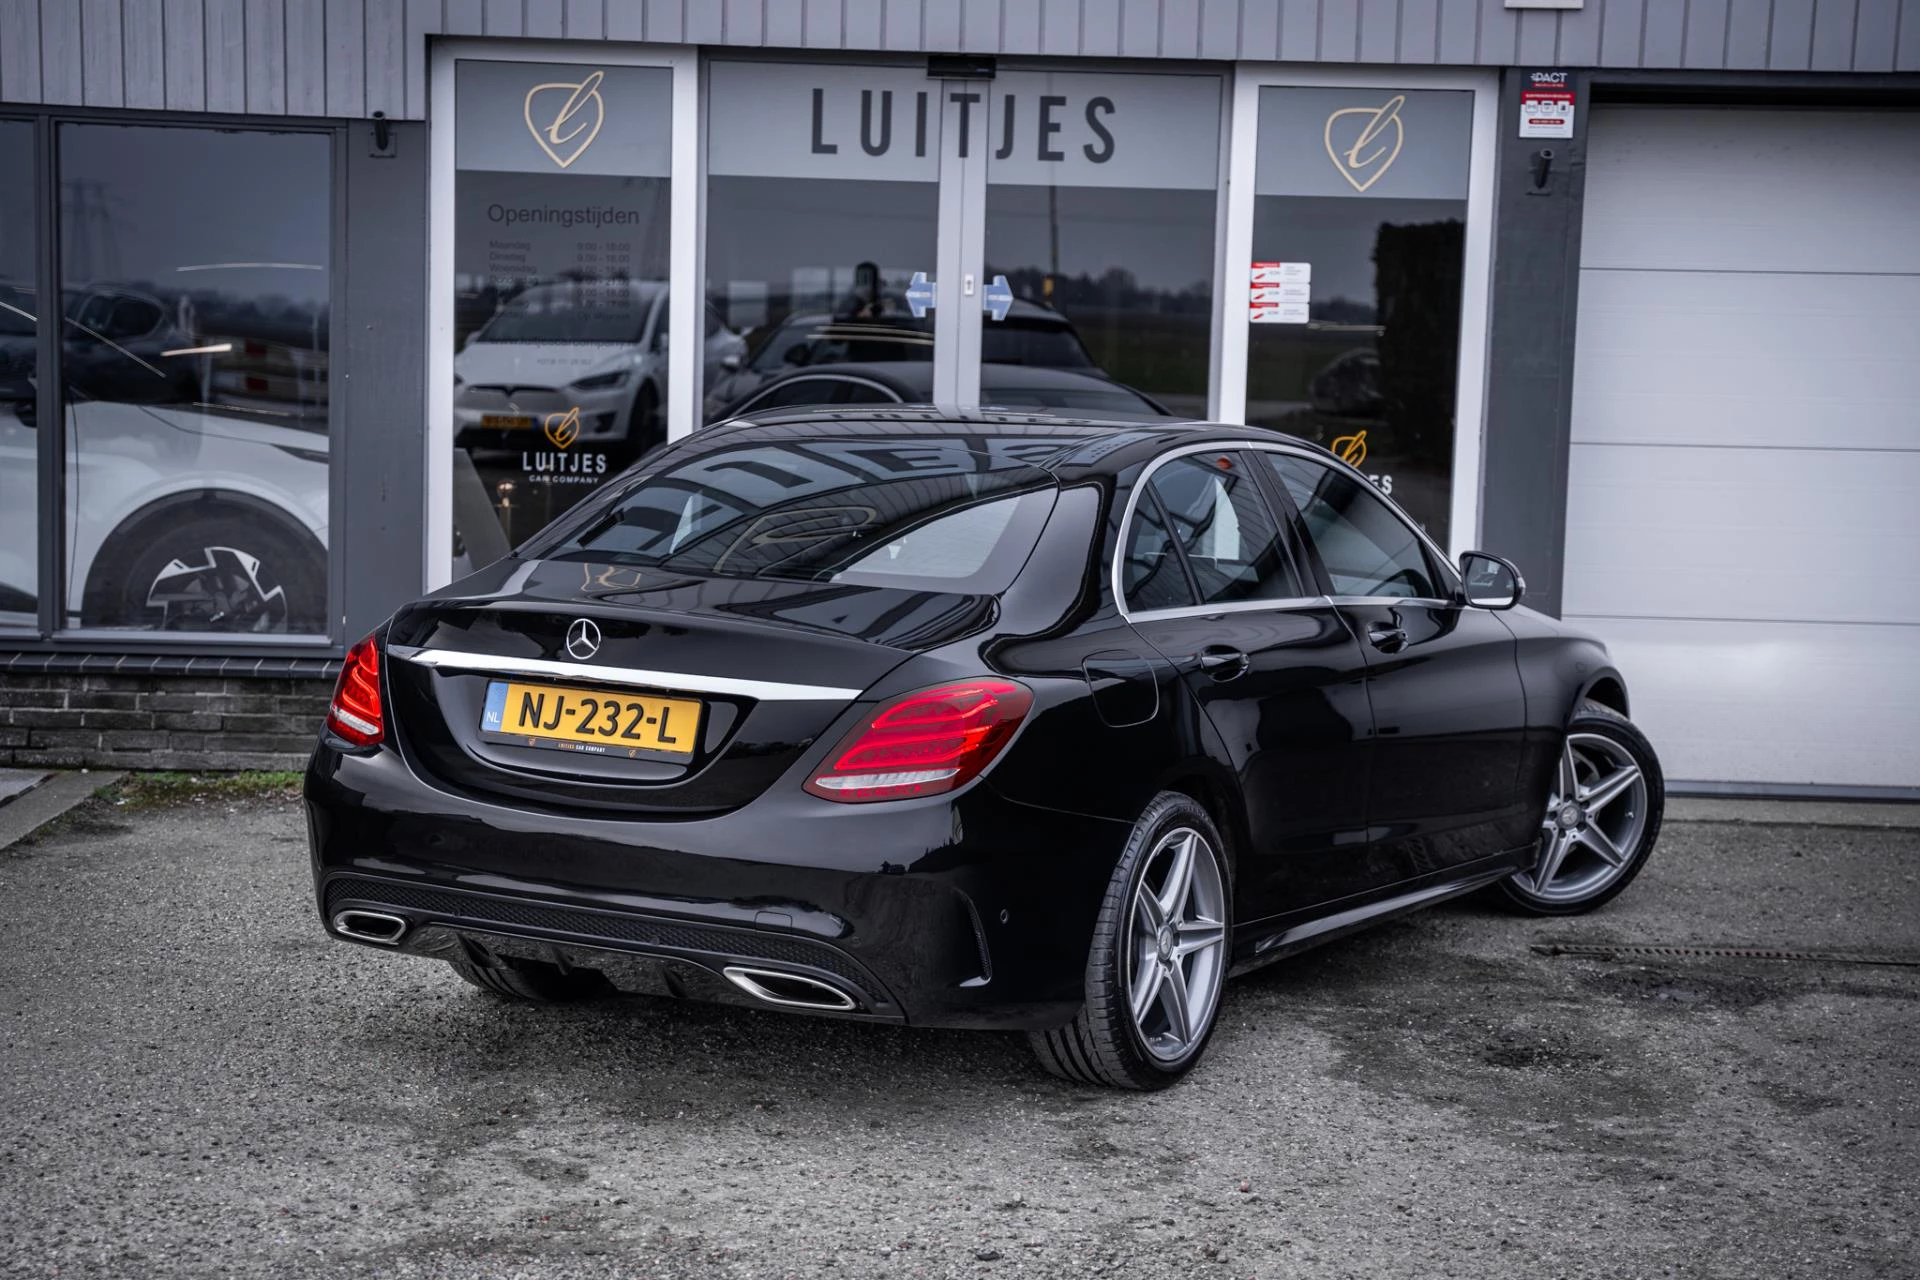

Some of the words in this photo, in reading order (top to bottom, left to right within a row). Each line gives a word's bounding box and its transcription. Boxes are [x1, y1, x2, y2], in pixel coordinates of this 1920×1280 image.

[811, 87, 1116, 164] LUITJES
[487, 203, 640, 228] Openingstijden
[522, 451, 607, 474] LUITJES
[552, 475, 599, 484] COMPANY
[486, 711, 500, 723] NL
[518, 691, 677, 744] NJ-232-L
